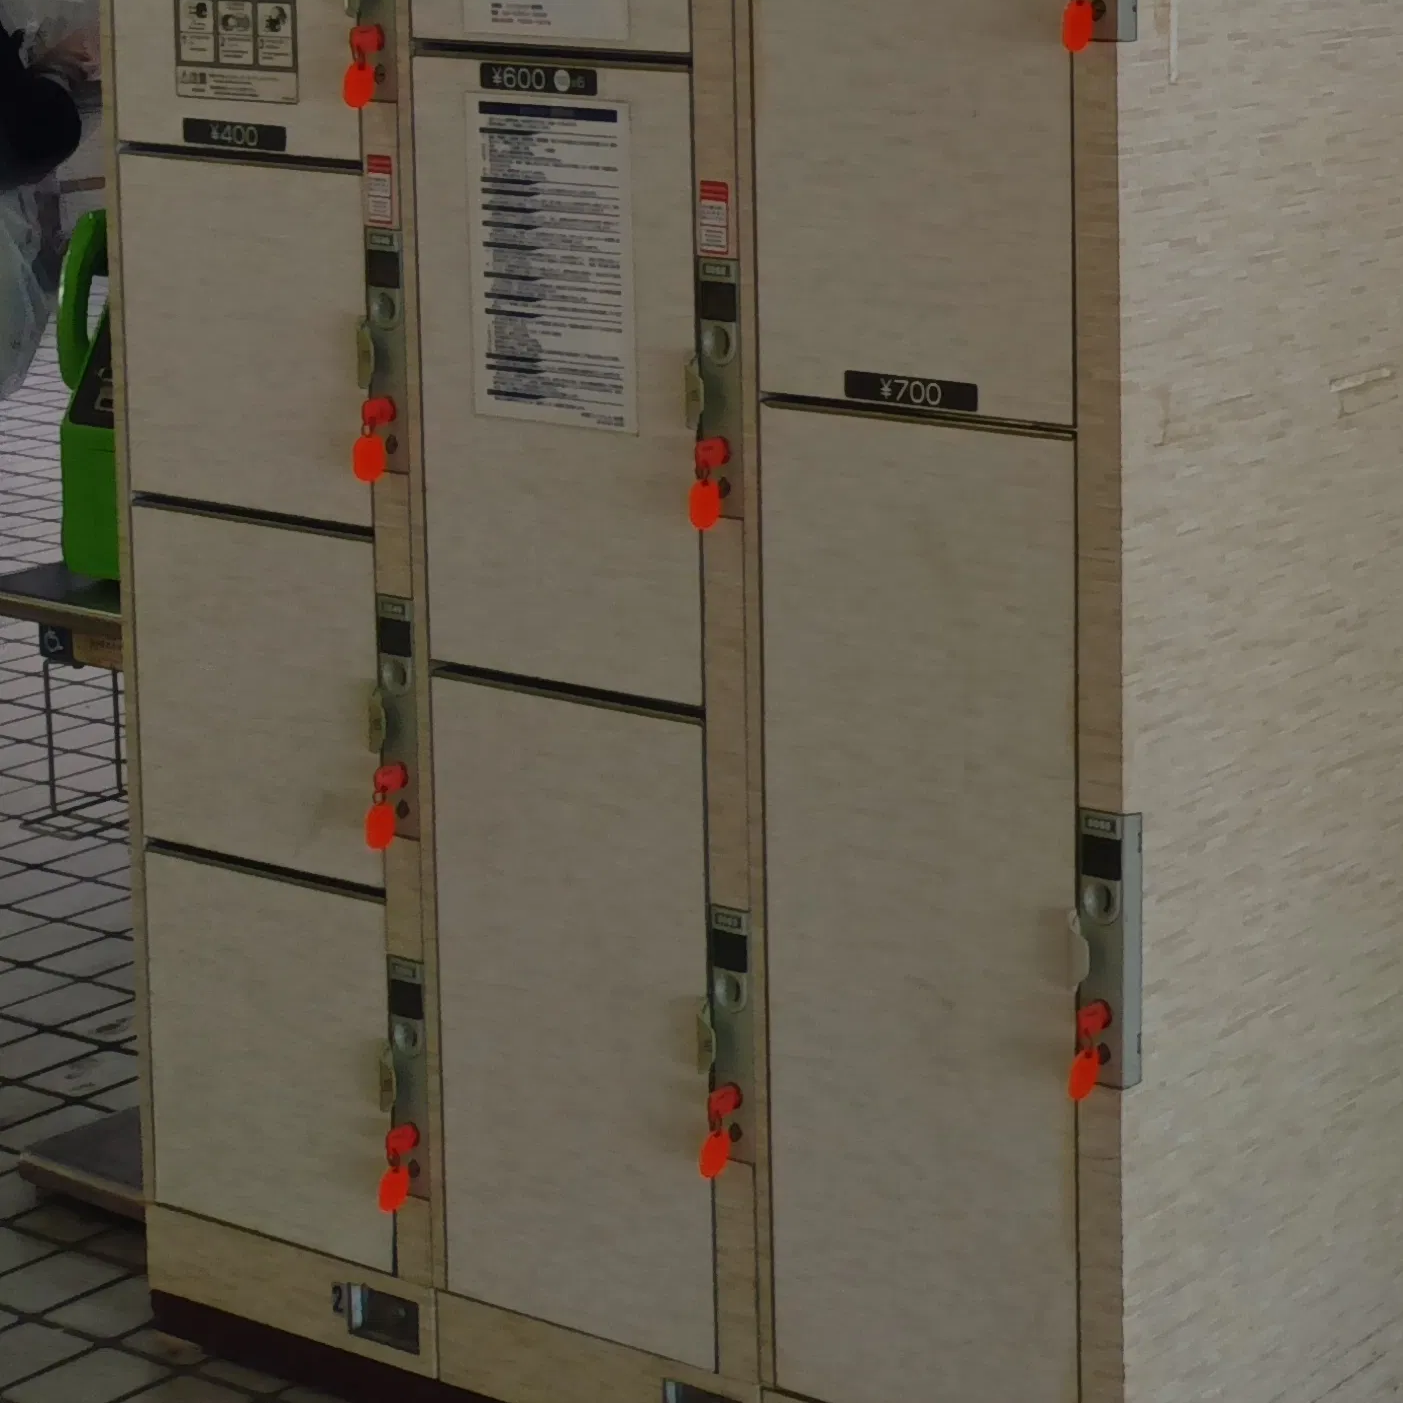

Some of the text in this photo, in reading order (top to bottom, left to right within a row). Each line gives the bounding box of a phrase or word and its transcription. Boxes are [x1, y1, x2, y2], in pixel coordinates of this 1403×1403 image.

[491, 66, 546, 90] ¥600
[208, 122, 259, 147] ¥400
[879, 377, 943, 406] ¥700
[331, 1284, 344, 1313] 2
